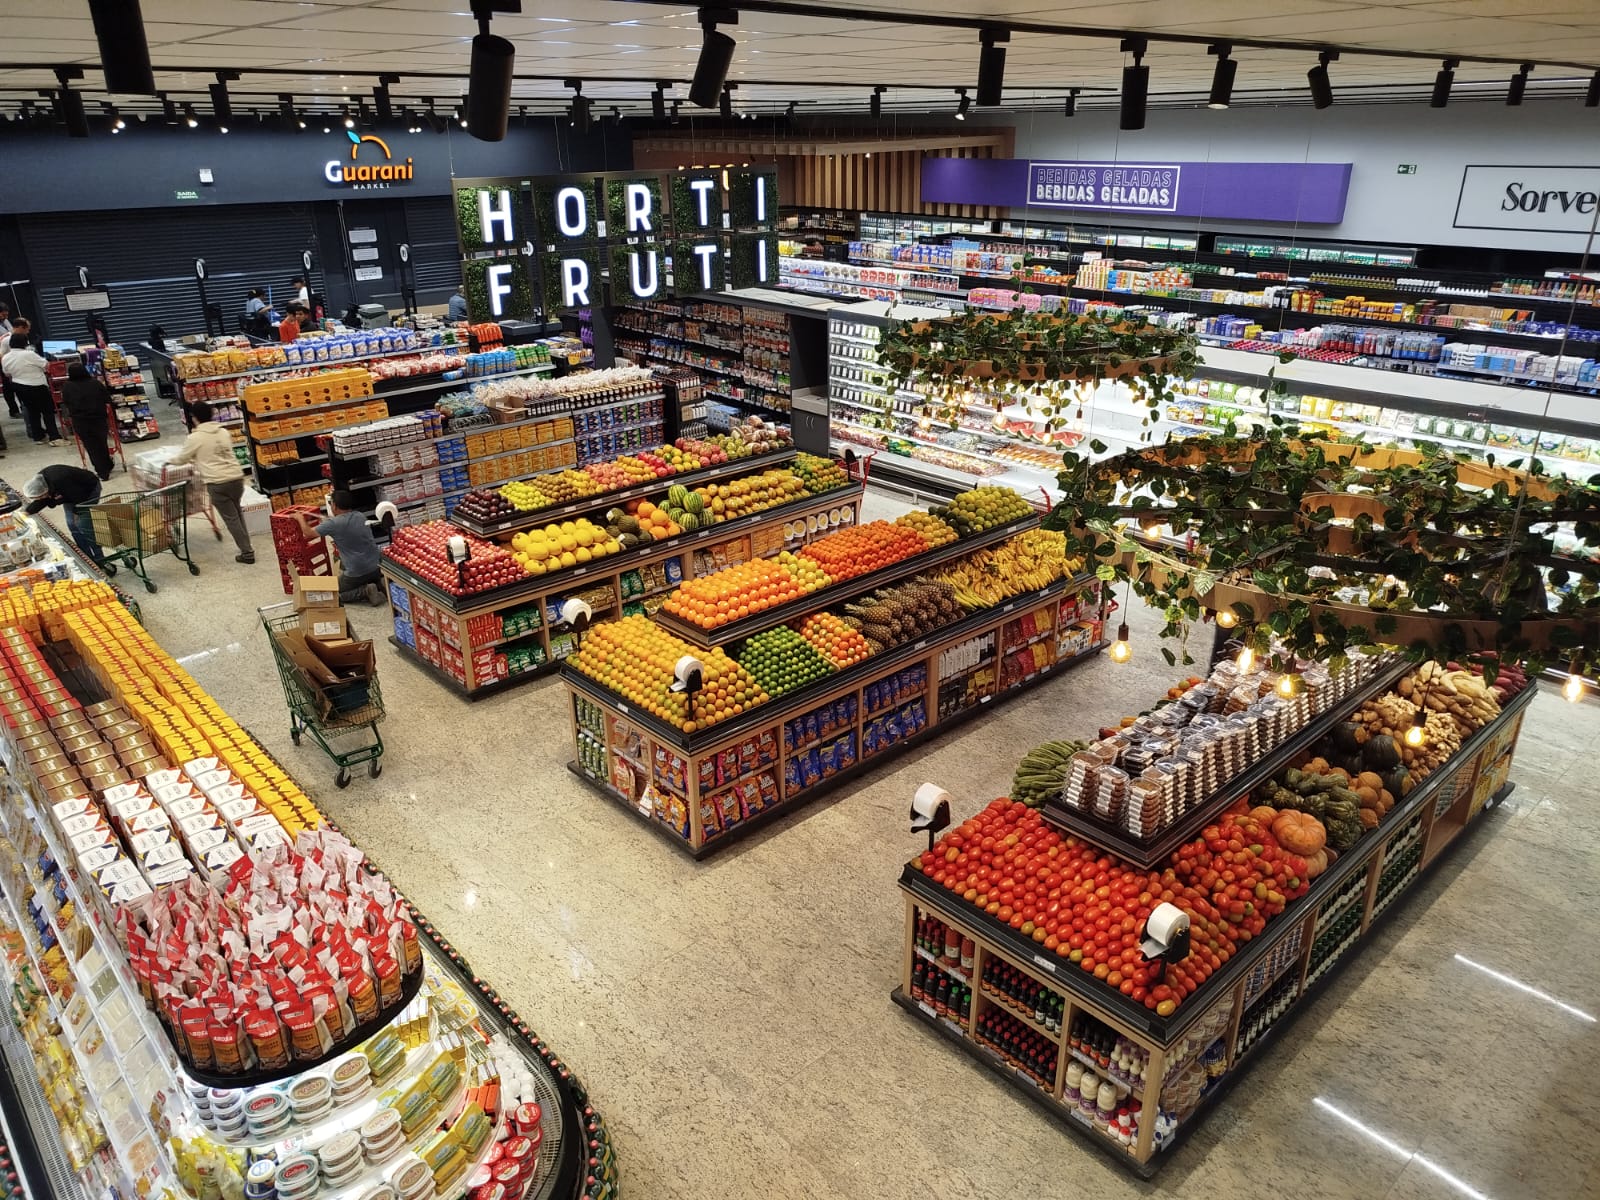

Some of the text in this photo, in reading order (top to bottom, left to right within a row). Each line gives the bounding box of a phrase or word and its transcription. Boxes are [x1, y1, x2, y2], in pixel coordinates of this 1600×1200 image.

[325, 157, 413, 182] Guarani
[1037, 168, 1172, 188] BEBIDAS GELADAS
[352, 182, 391, 190] MARKET
[1036, 184, 1170, 206] BEBIDAS GELADAS
